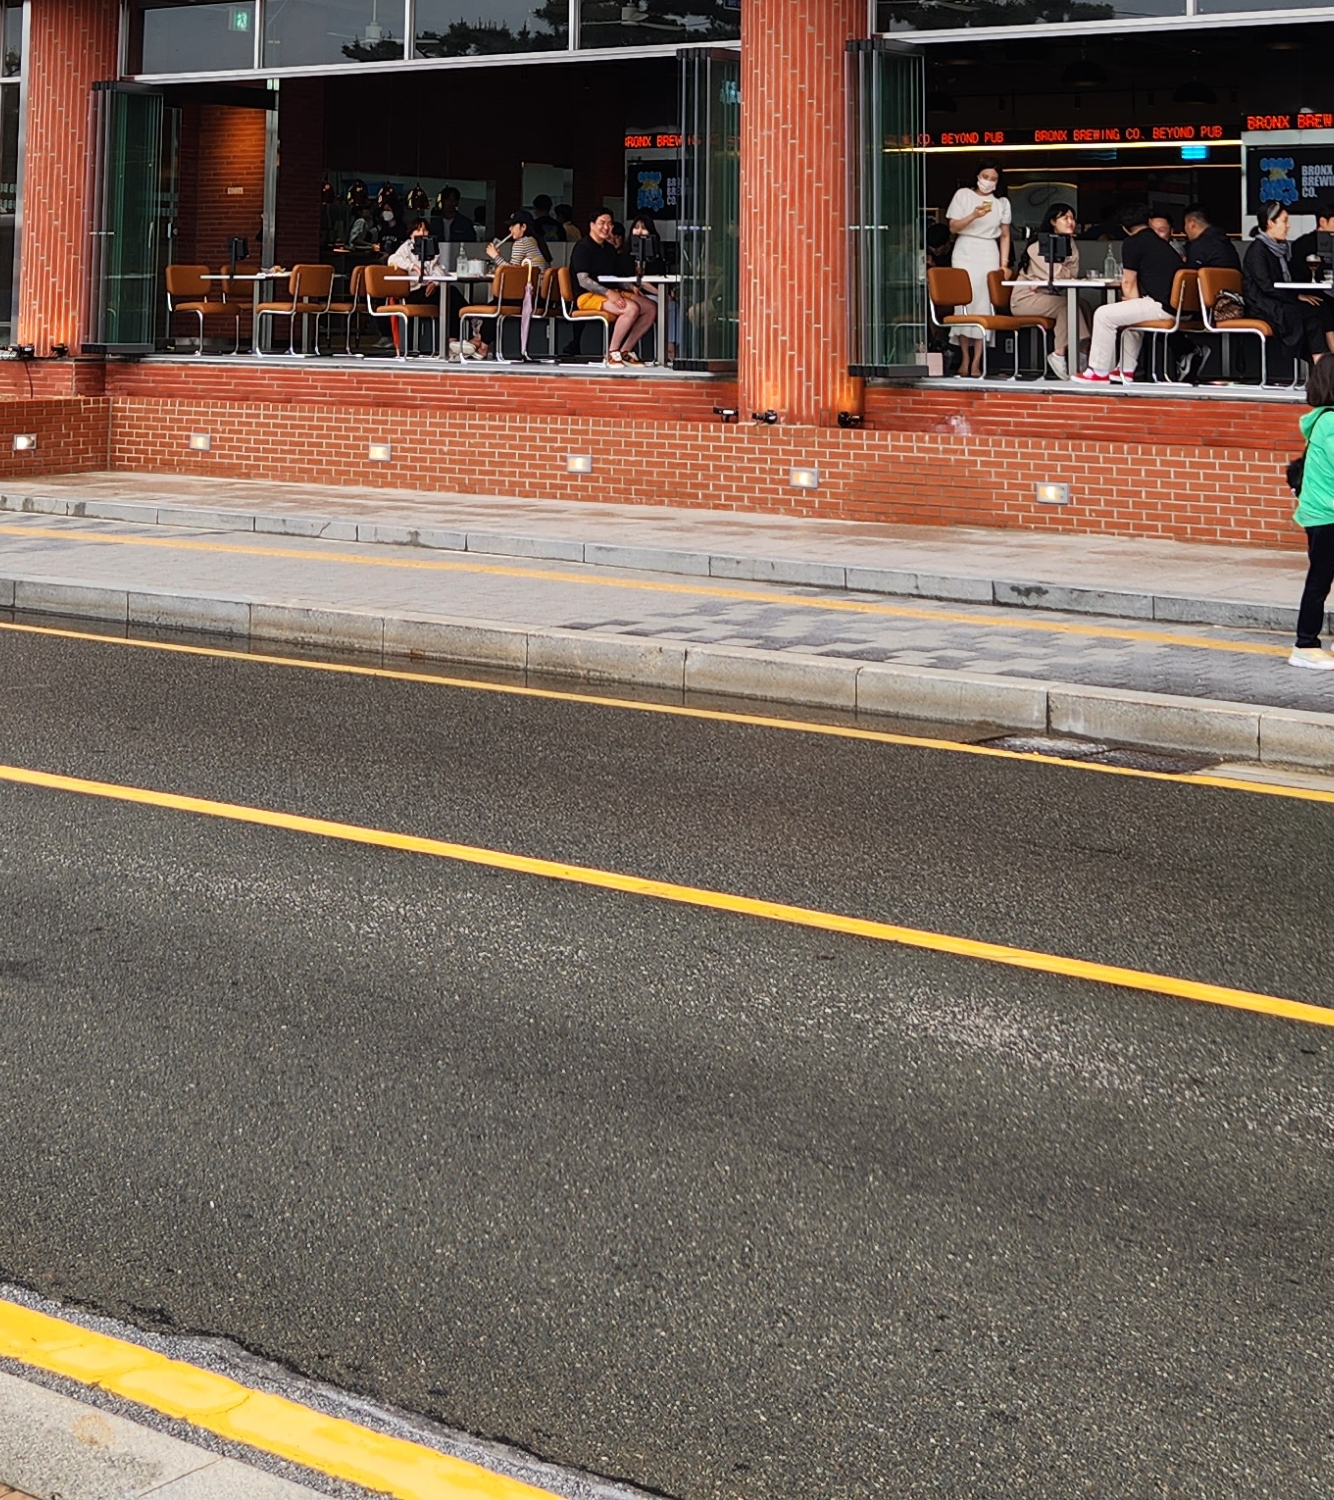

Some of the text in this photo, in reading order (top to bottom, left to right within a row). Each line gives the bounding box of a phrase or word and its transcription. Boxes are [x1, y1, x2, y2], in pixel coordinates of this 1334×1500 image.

[1246, 115, 1290, 130] BRONX
[941, 132, 979, 145] BEYOND
[984, 131, 1004, 143] PUB
[1035, 130, 1067, 143] BRONX
[1073, 129, 1121, 142] BREWING
[1152, 126, 1195, 139] BEYOND
[1200, 125, 1224, 138] PUB
[1301, 164, 1334, 176] BRONX
[1301, 186, 1318, 198] CO.
